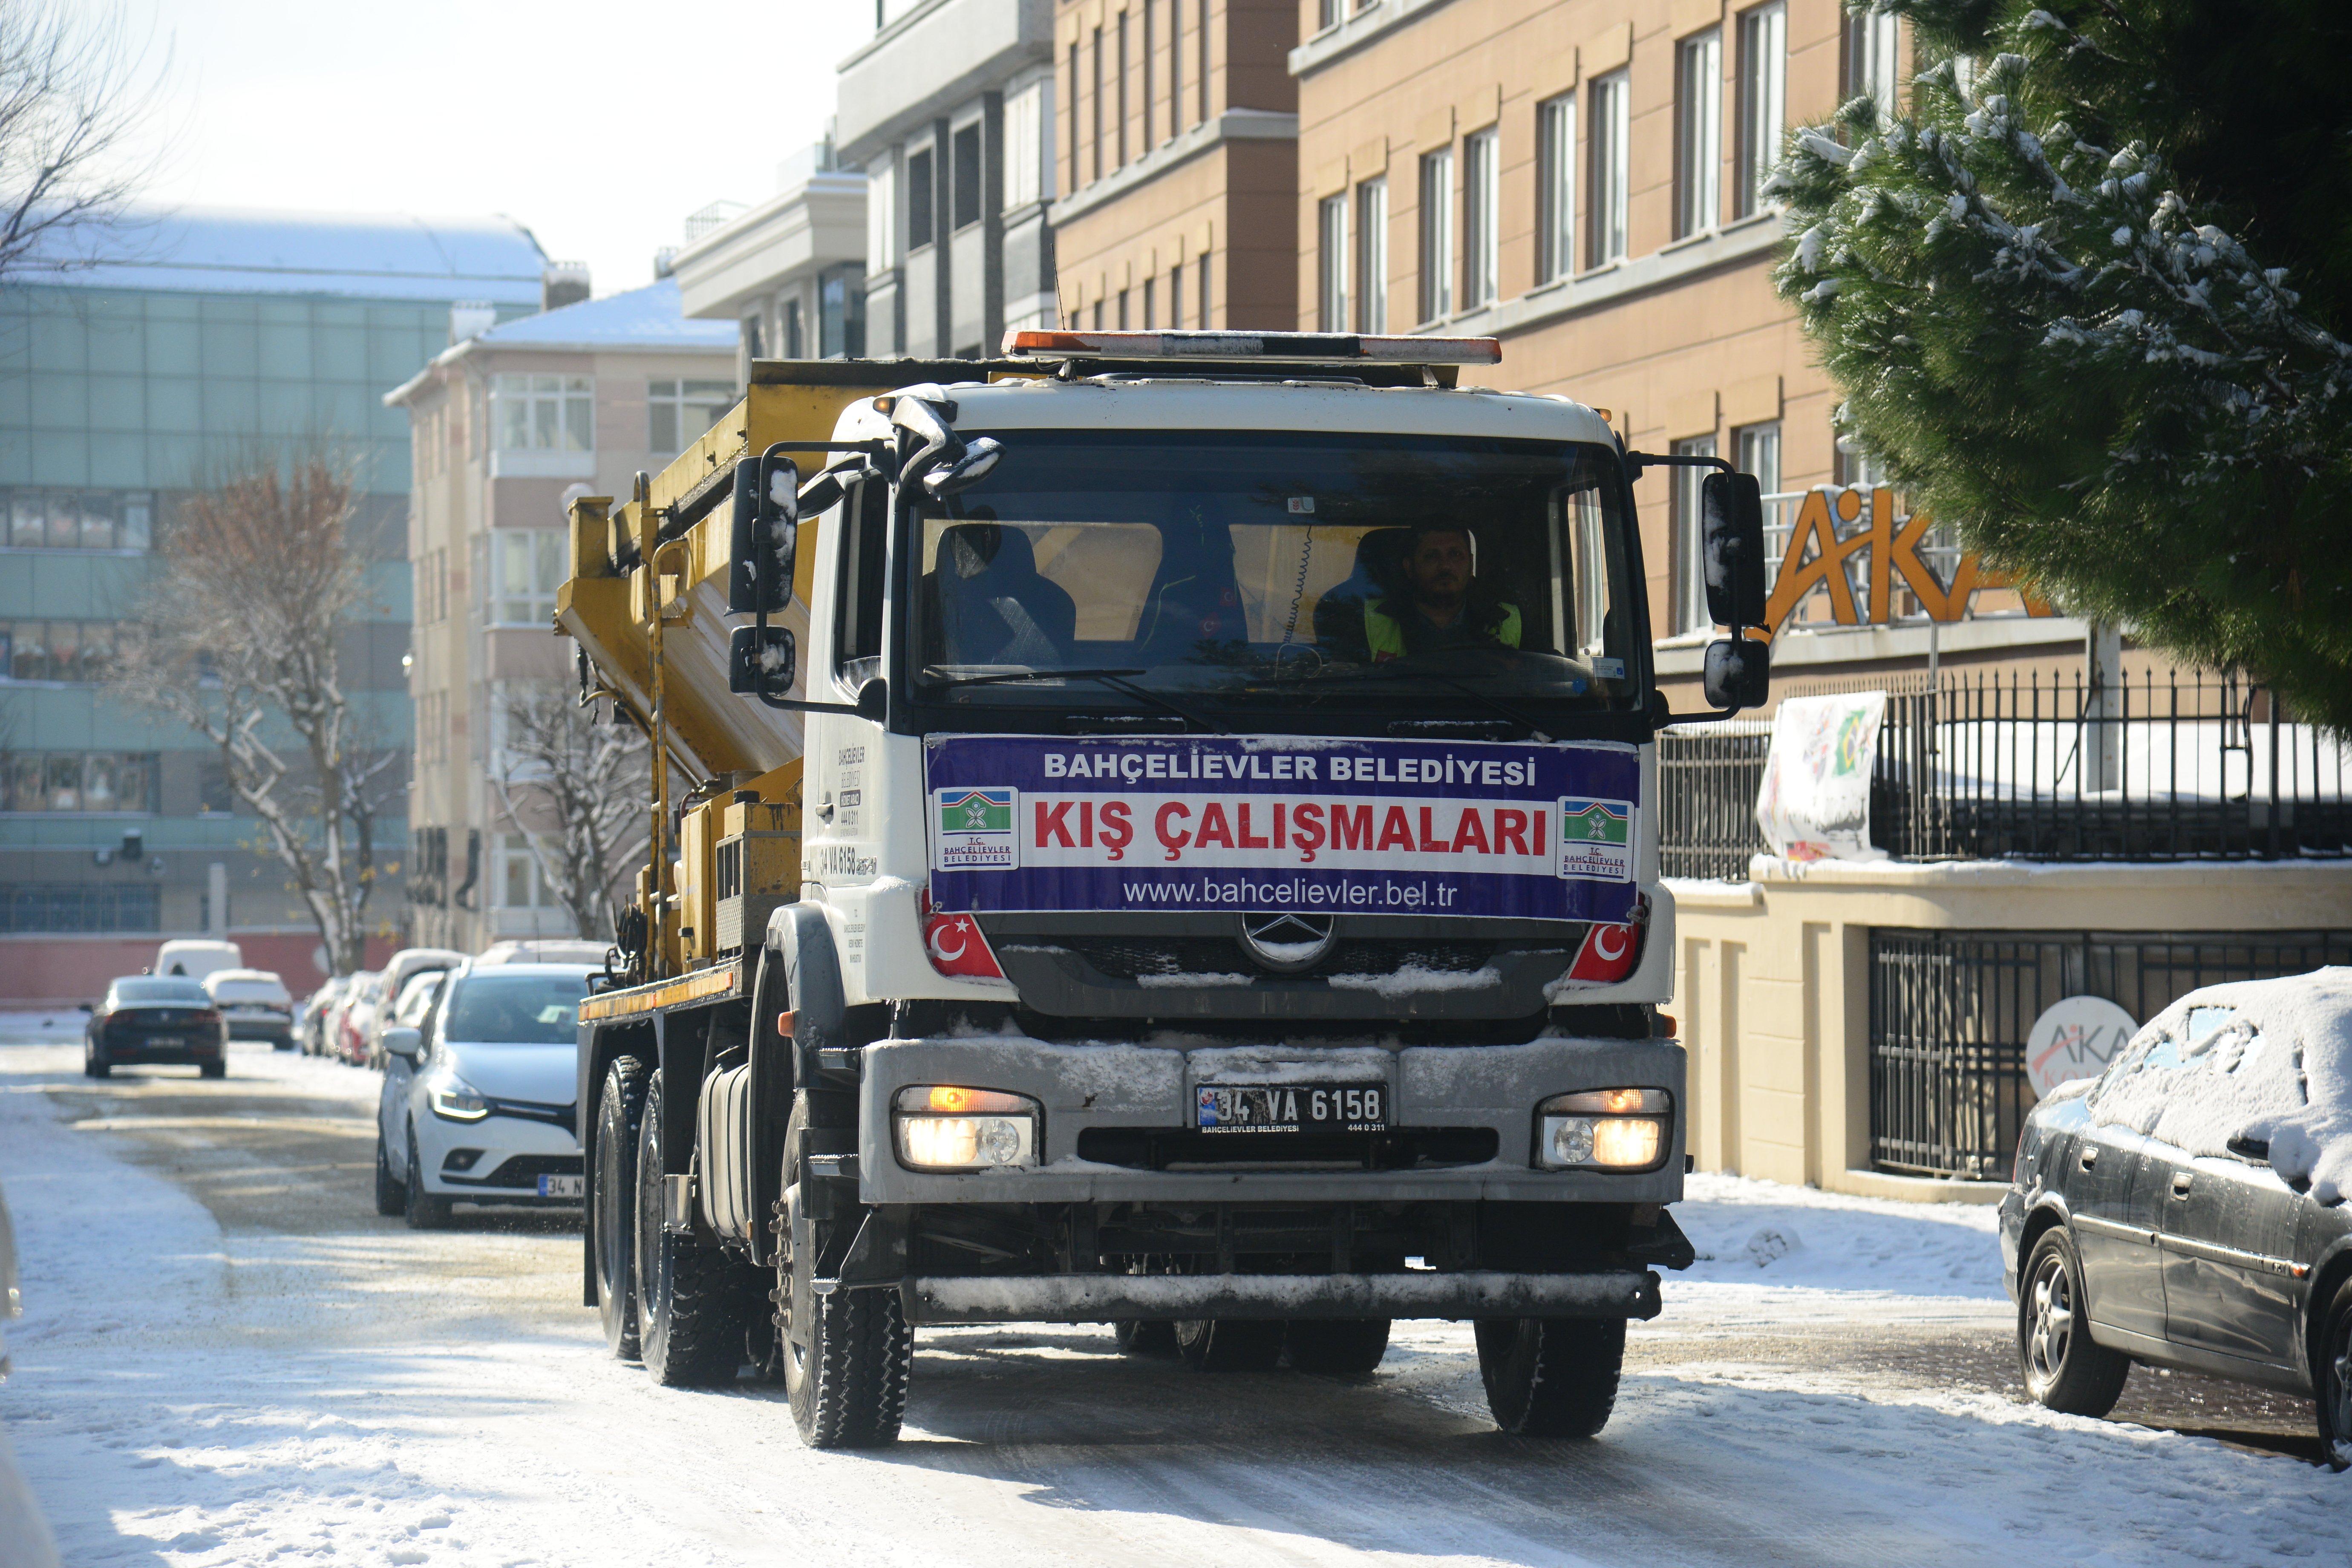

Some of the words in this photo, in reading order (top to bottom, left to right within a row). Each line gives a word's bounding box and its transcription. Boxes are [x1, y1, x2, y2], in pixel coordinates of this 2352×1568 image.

[1044, 748, 1318, 784] BAHÇELİEVLER
[1330, 754, 1536, 786] BELEDİYESİ
[1035, 801, 1134, 861] KIŞ
[1154, 801, 1546, 862] ÇALIŞMALARI
[820, 848, 827, 875] 34
[830, 846, 838, 874] VA
[839, 846, 855, 875] 6158
[944, 853, 1010, 862] BELEDİYESİ
[945, 845, 1010, 854] BAHÇELİEVLER
[1565, 855, 1624, 866] BAHÇELİEVLER
[1564, 864, 1624, 874] BELEDİYESİ
[1124, 877, 1457, 906] www.bahcelievler.bel.tr
[1217, 1090, 1249, 1121] 34
[1266, 1090, 1297, 1121] VA
[1312, 1090, 1379, 1120] 6158
[549, 1177, 565, 1193] 34
